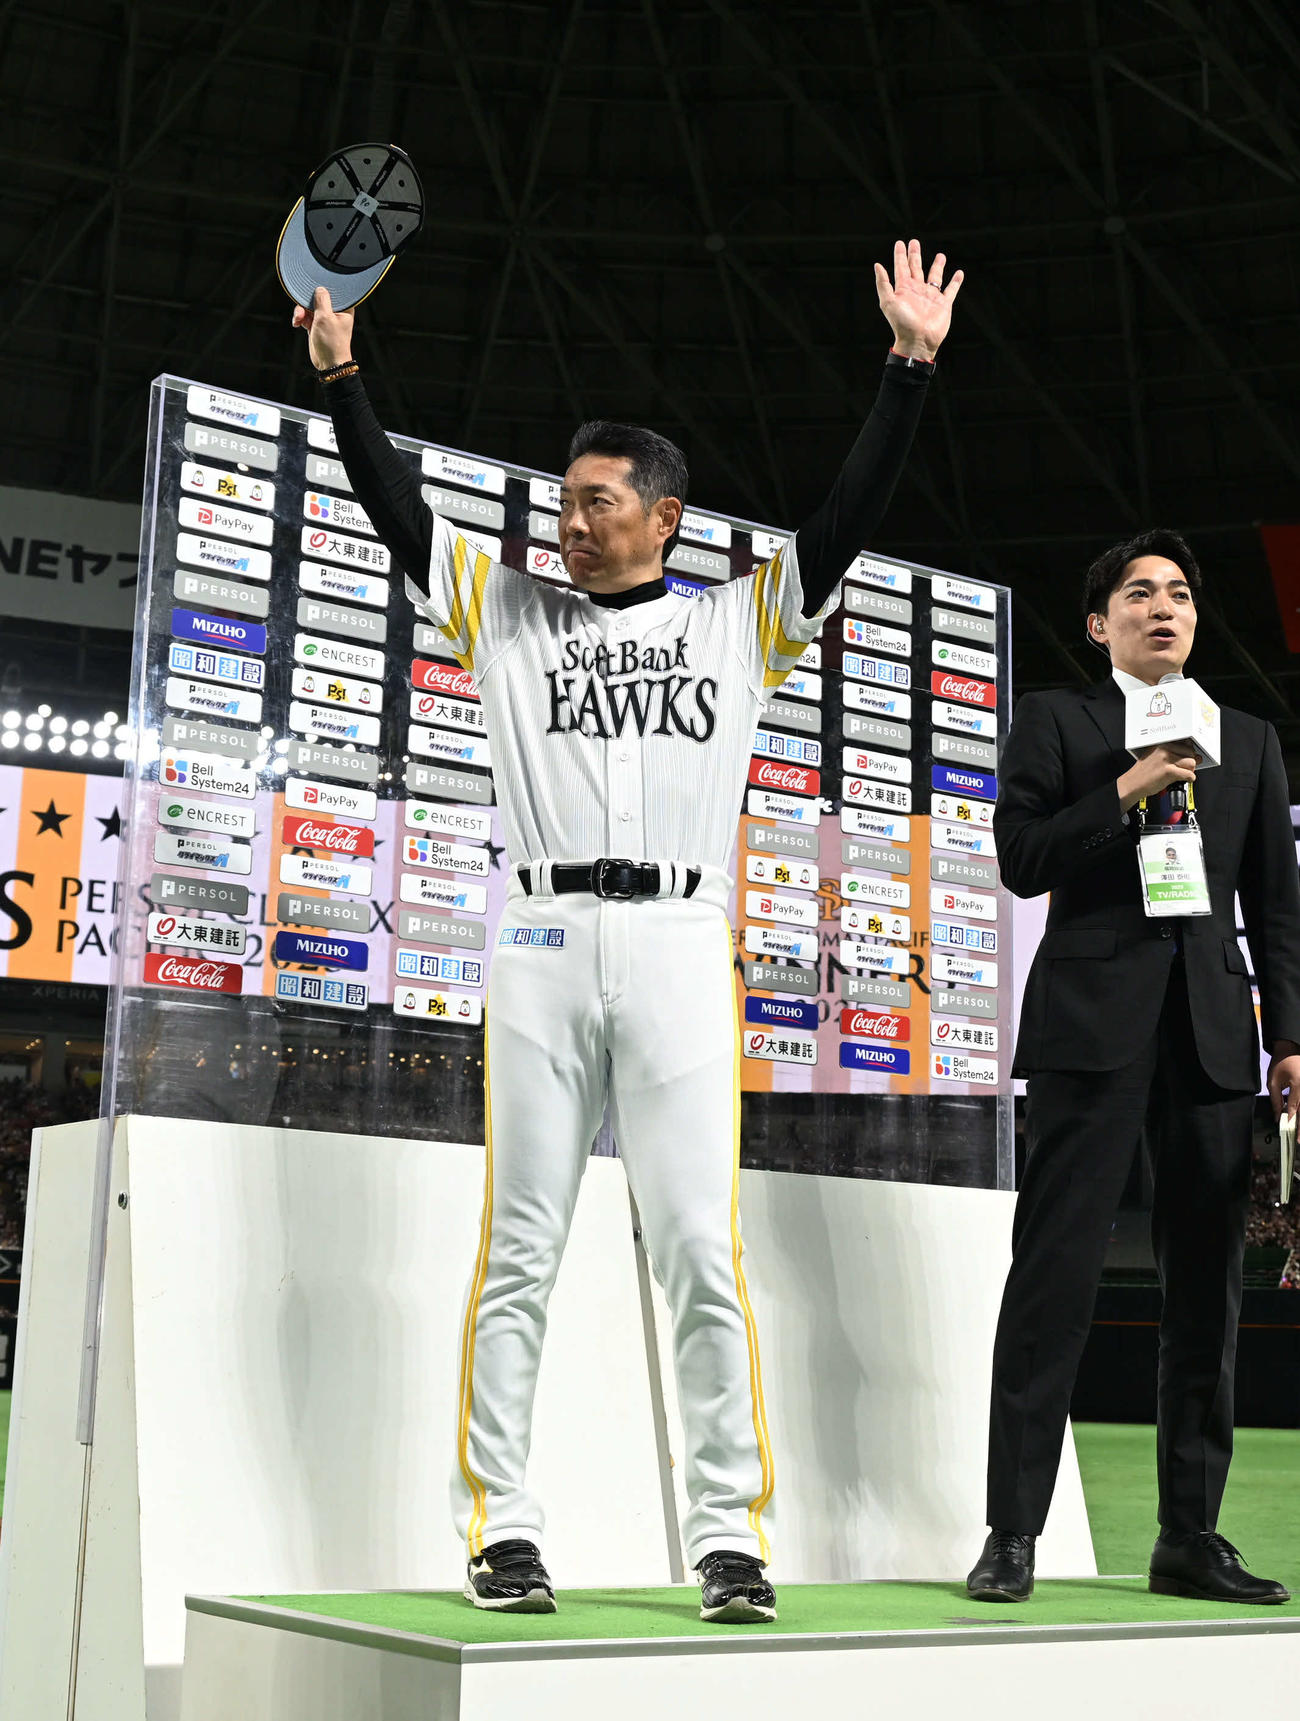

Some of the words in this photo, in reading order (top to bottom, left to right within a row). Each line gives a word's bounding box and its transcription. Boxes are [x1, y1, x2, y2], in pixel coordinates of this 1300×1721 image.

[210, 436, 267, 458] PERSOL
[334, 500, 353, 514] Bell
[445, 497, 494, 517] PERSOL
[215, 514, 254, 533] PayPay
[333, 512, 374, 529] System
[328, 539, 385, 566] 大東建託
[677, 551, 721, 569] PERSOL
[200, 583, 257, 603] PERSOL
[863, 596, 904, 613] PERSOL
[193, 617, 246, 639] MIZUHO
[323, 611, 376, 629] PERSOL
[950, 617, 989, 633] PERSOL
[866, 624, 881, 636] Bell
[866, 634, 907, 652] System24
[562, 637, 688, 676] SoftBank
[172, 647, 261, 684] 昭和建設
[845, 655, 908, 685] 昭和建設
[940, 677, 987, 701] Coca-Cola
[545, 670, 718, 743] HAWKS
[770, 705, 813, 721] PERSOL
[190, 729, 247, 748] PERSOL
[862, 723, 903, 739] PERSOL
[754, 732, 819, 762] 昭和建設
[950, 743, 990, 758] PERSOL
[192, 763, 213, 776] Bell
[314, 754, 368, 770] PERSOL
[869, 758, 898, 773] PayPay
[191, 775, 249, 794] System24
[431, 775, 482, 792] PERSOL
[758, 763, 810, 790] Coca-Cola
[947, 772, 983, 788] MIZUHO
[320, 792, 358, 809] PayPay
[864, 786, 907, 806] 大東建託
[296, 821, 361, 851] Coca-Cola
[768, 833, 811, 848] PERSOL
[432, 842, 451, 855] Bell
[861, 849, 902, 864] PERSOL
[431, 854, 484, 872] System24
[950, 864, 989, 878] PERSOL
[178, 884, 236, 901] PERSOL
[1156, 890, 1194, 899] TV/RADI
[305, 905, 360, 920] PERSOL
[774, 903, 804, 917] PayPay
[956, 897, 985, 911] PayPay
[177, 923, 240, 947] 大東建託
[424, 921, 475, 938] PERSOL
[499, 928, 564, 946] 昭和建設
[933, 924, 995, 949] 昭和建設
[297, 940, 348, 957] MIZUHO
[158, 958, 228, 987] Coca-Cola
[399, 953, 480, 983] 昭和建設
[765, 969, 808, 984] PERSOL
[279, 975, 365, 1005] 昭和建設
[860, 983, 903, 997] PERSOL
[761, 1003, 802, 1018] MIZUHO
[949, 995, 990, 1009] PERSOL
[851, 1013, 900, 1037] Coca-Cola
[951, 1028, 994, 1046] 大東建託
[766, 1039, 813, 1059] 大東建託
[855, 1049, 895, 1064] MIZUHO
[954, 1058, 968, 1068] Bell
[953, 1069, 994, 1082] System24
